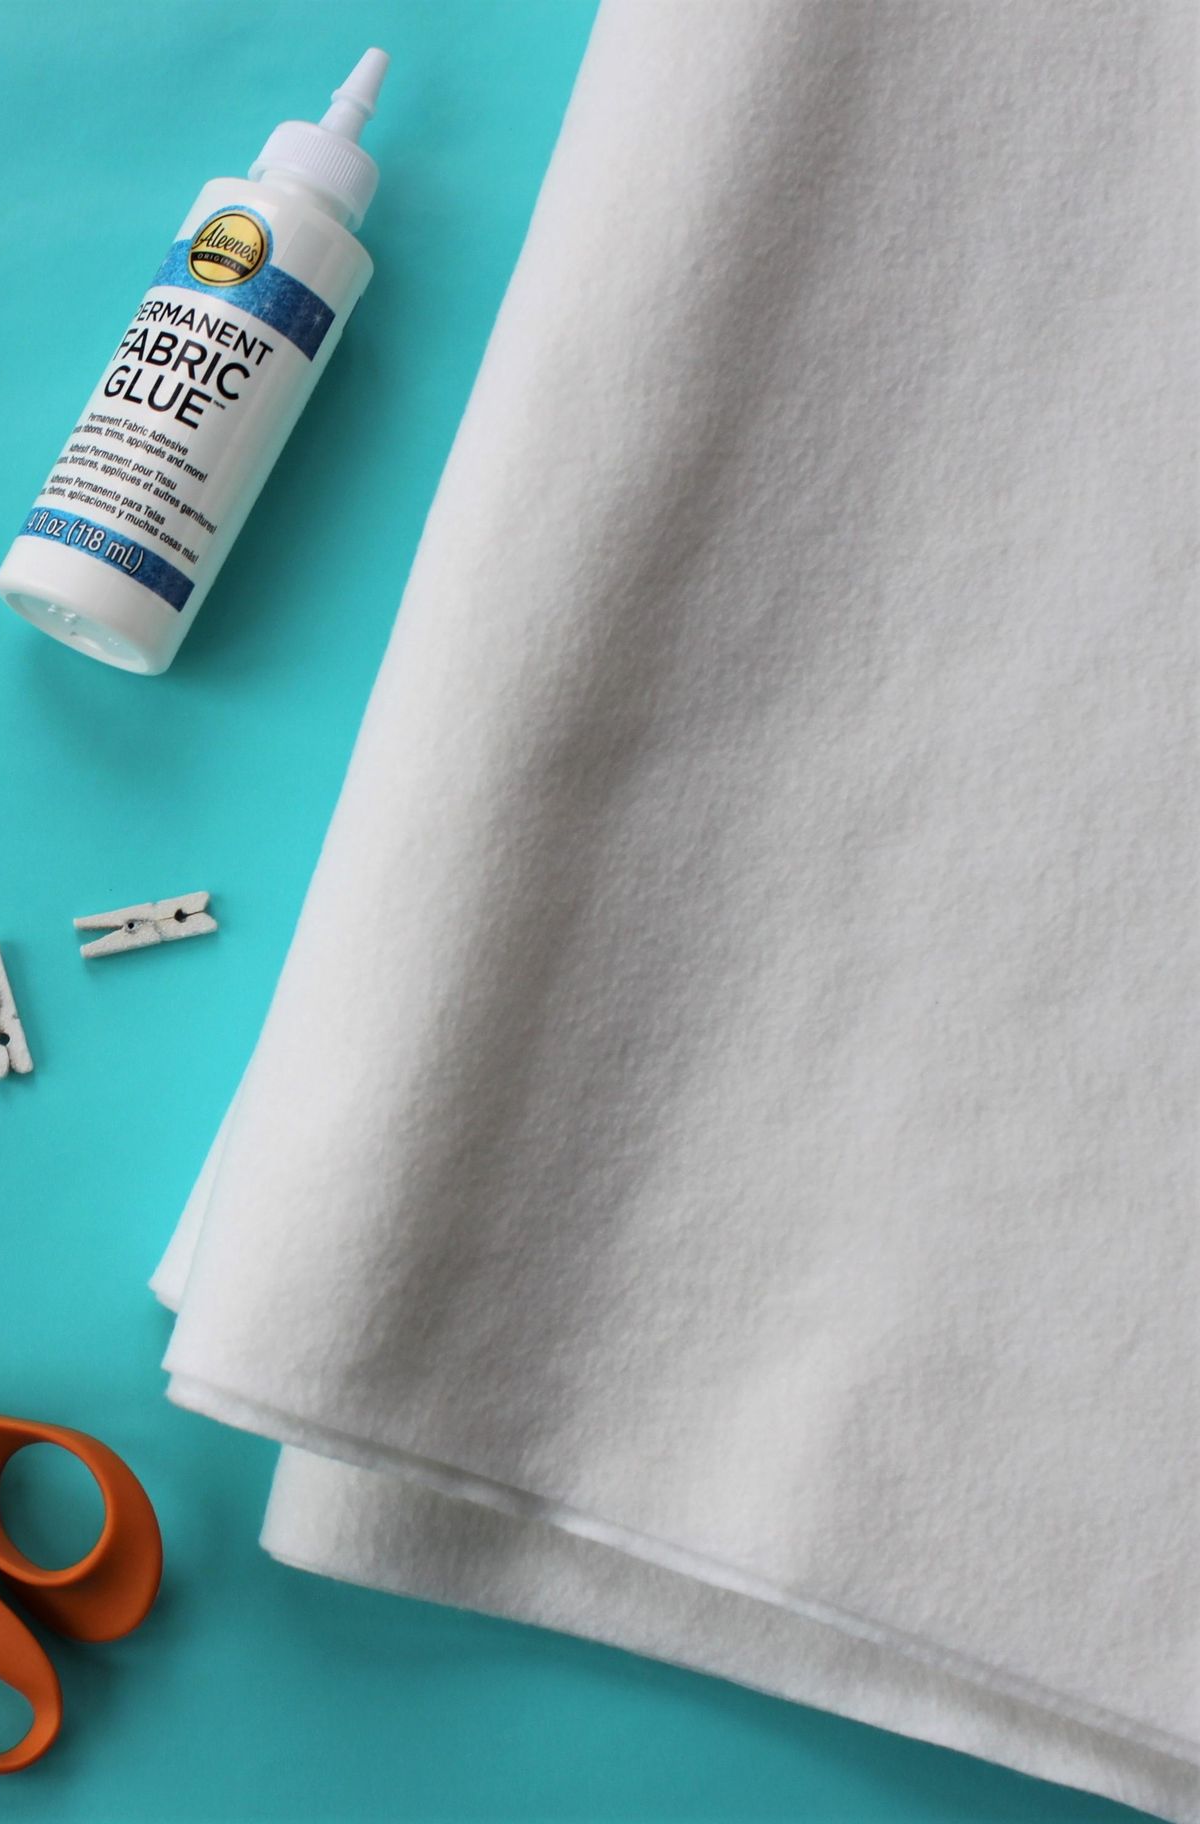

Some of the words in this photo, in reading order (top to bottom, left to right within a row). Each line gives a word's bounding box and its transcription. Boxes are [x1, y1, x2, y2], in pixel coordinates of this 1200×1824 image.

[197, 253, 241, 271] ORIGINAL
[113, 327, 251, 400] FABRIC
[88, 412, 122, 425] Permanent
[122, 419, 149, 436] Fabric
[149, 430, 189, 456] Adhesive
[104, 427, 124, 443] trims,
[167, 454, 185, 469] and
[183, 463, 208, 483] more!
[89, 446, 132, 468] Permanent
[132, 462, 154, 477] pour
[155, 471, 178, 490] Tissu
[68, 491, 116, 514] aplicaciones
[116, 509, 125, 518] y
[125, 512, 159, 536] muchas
[159, 532, 182, 552] cosas
[73, 477, 121, 501] Permanente
[121, 497, 143, 512] para
[143, 505, 166, 525] Telas
[100, 464, 141, 486] appliques
[143, 482, 153, 492] et
[153, 488, 180, 507] autres
[180, 504, 217, 535] garnitures!
[27, 511, 39, 529] 4
[34, 511, 50, 531] fl
[46, 519, 68, 537] oz
[66, 519, 105, 551] (118
[104, 541, 144, 575] mL)
